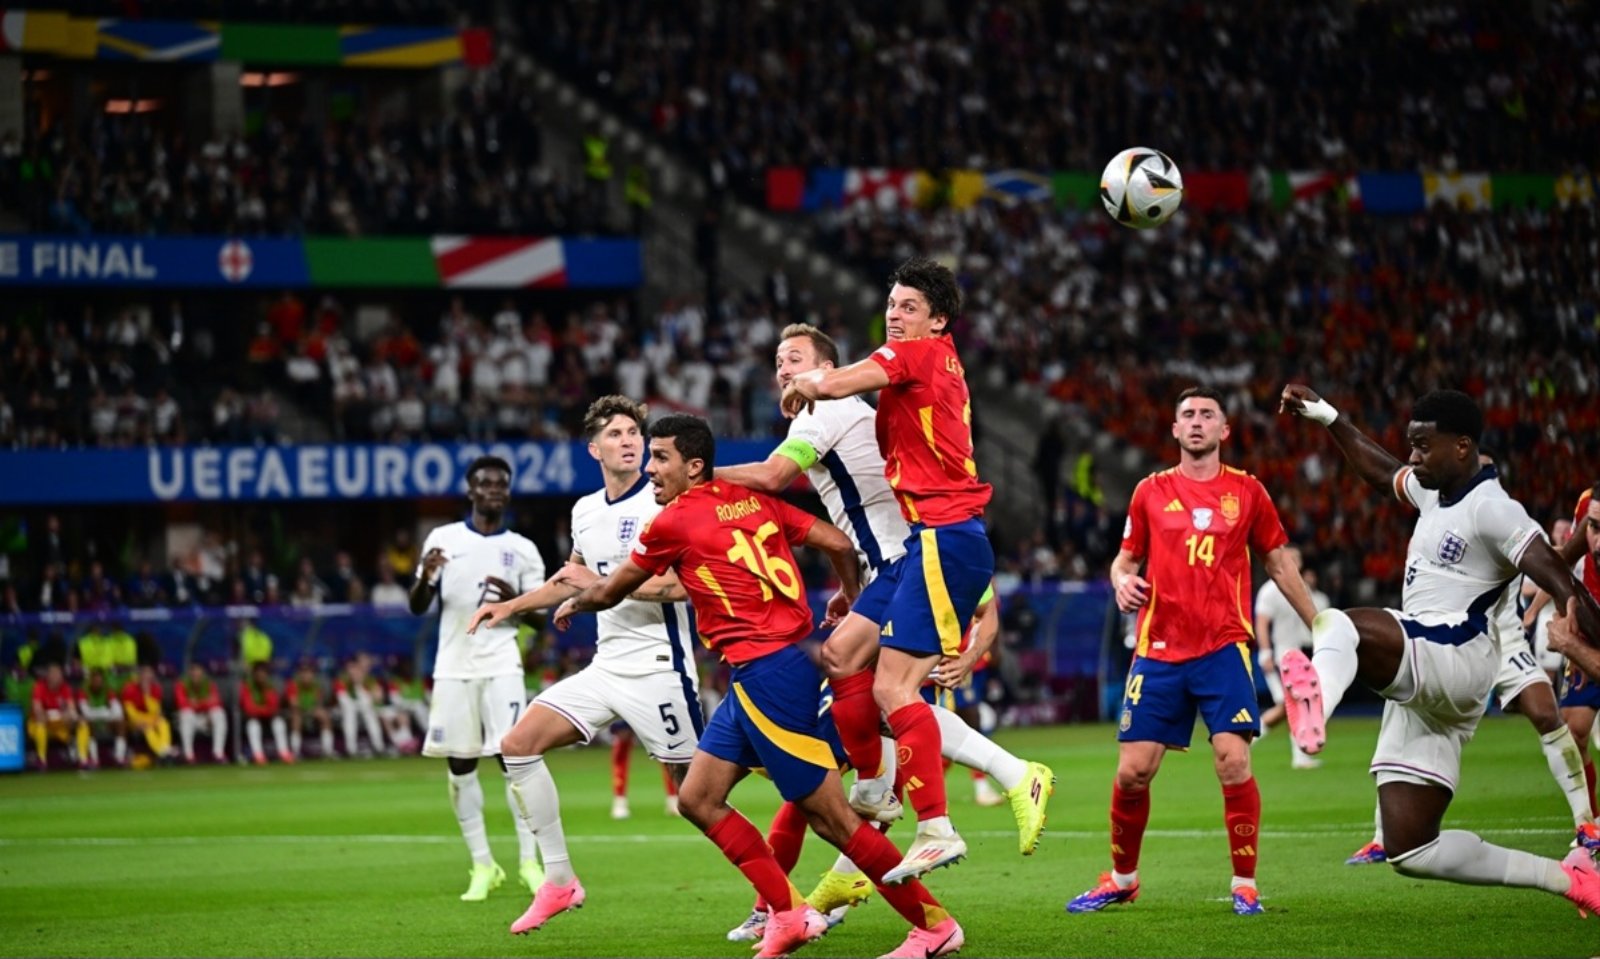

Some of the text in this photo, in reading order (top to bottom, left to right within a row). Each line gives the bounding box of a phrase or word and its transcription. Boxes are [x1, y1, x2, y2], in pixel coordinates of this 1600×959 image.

[33, 241, 157, 279] FINAL
[715, 496, 761, 522] RODRIGO
[726, 520, 800, 602] 16
[1185, 534, 1215, 567] 14
[1508, 651, 1537, 671] 10
[509, 701, 520, 726] 7
[658, 702, 680, 736] 5
